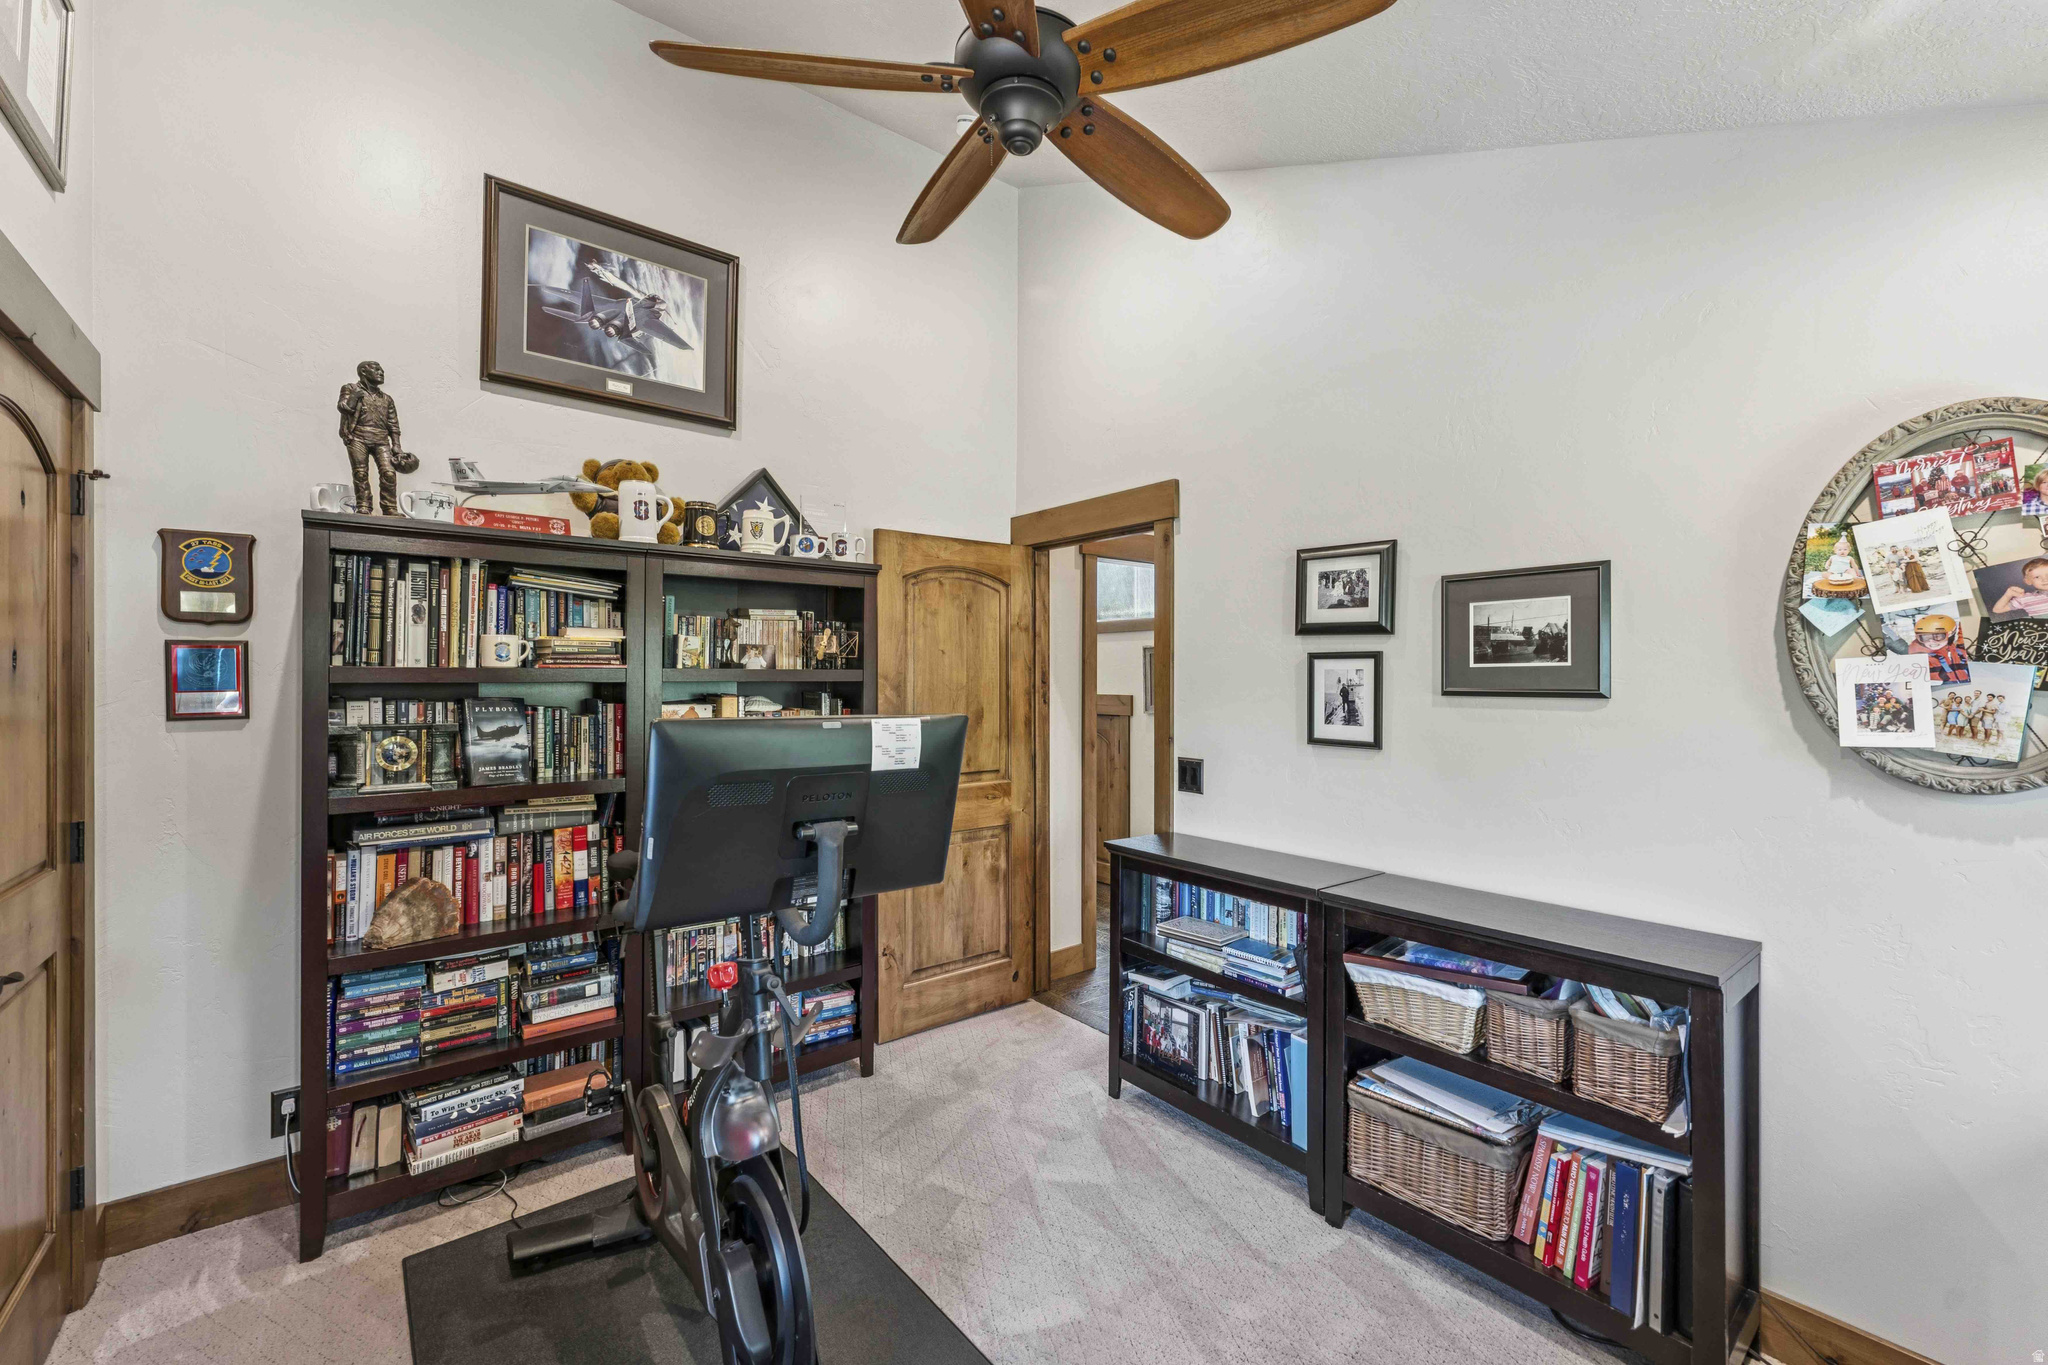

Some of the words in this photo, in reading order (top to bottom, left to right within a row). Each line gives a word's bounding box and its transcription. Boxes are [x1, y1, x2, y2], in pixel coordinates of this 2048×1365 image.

[410, 570, 427, 602] HISTORY
[1987, 629, 2038, 648] New
[1986, 645, 2043, 664] Year
[1838, 664, 1885, 687] New
[1888, 663, 1932, 682] Year
[802, 792, 853, 802] PELOTON
[374, 830, 408, 839] FORCES
[426, 824, 457, 833] WORLD
[558, 850, 572, 875] 1421
[398, 864, 406, 886] USEFUL
[534, 1008, 572, 1020] PYNCHON
[584, 1001, 597, 1010] THE
[598, 999, 609, 1007] DAY
[418, 1097, 437, 1106] BUSINESS
[444, 1090, 460, 1099] AMERICA
[493, 1075, 508, 1083] GORDON
[470, 1094, 493, 1104] Winter
[495, 1089, 508, 1097] Sky
[441, 1124, 474, 1137] BATTLES!
[464, 1132, 481, 1141] ARAB
[453, 1137, 481, 1148] PEOPLES
[422, 1160, 434, 1172] WAY
[436, 1158, 443, 1166] OF
[445, 1147, 475, 1163] DECEPTION
[1535, 1139, 1547, 1171] SPANISH
[1570, 1161, 1578, 1178] MAYO
[1528, 1172, 1539, 1194] NOW!
